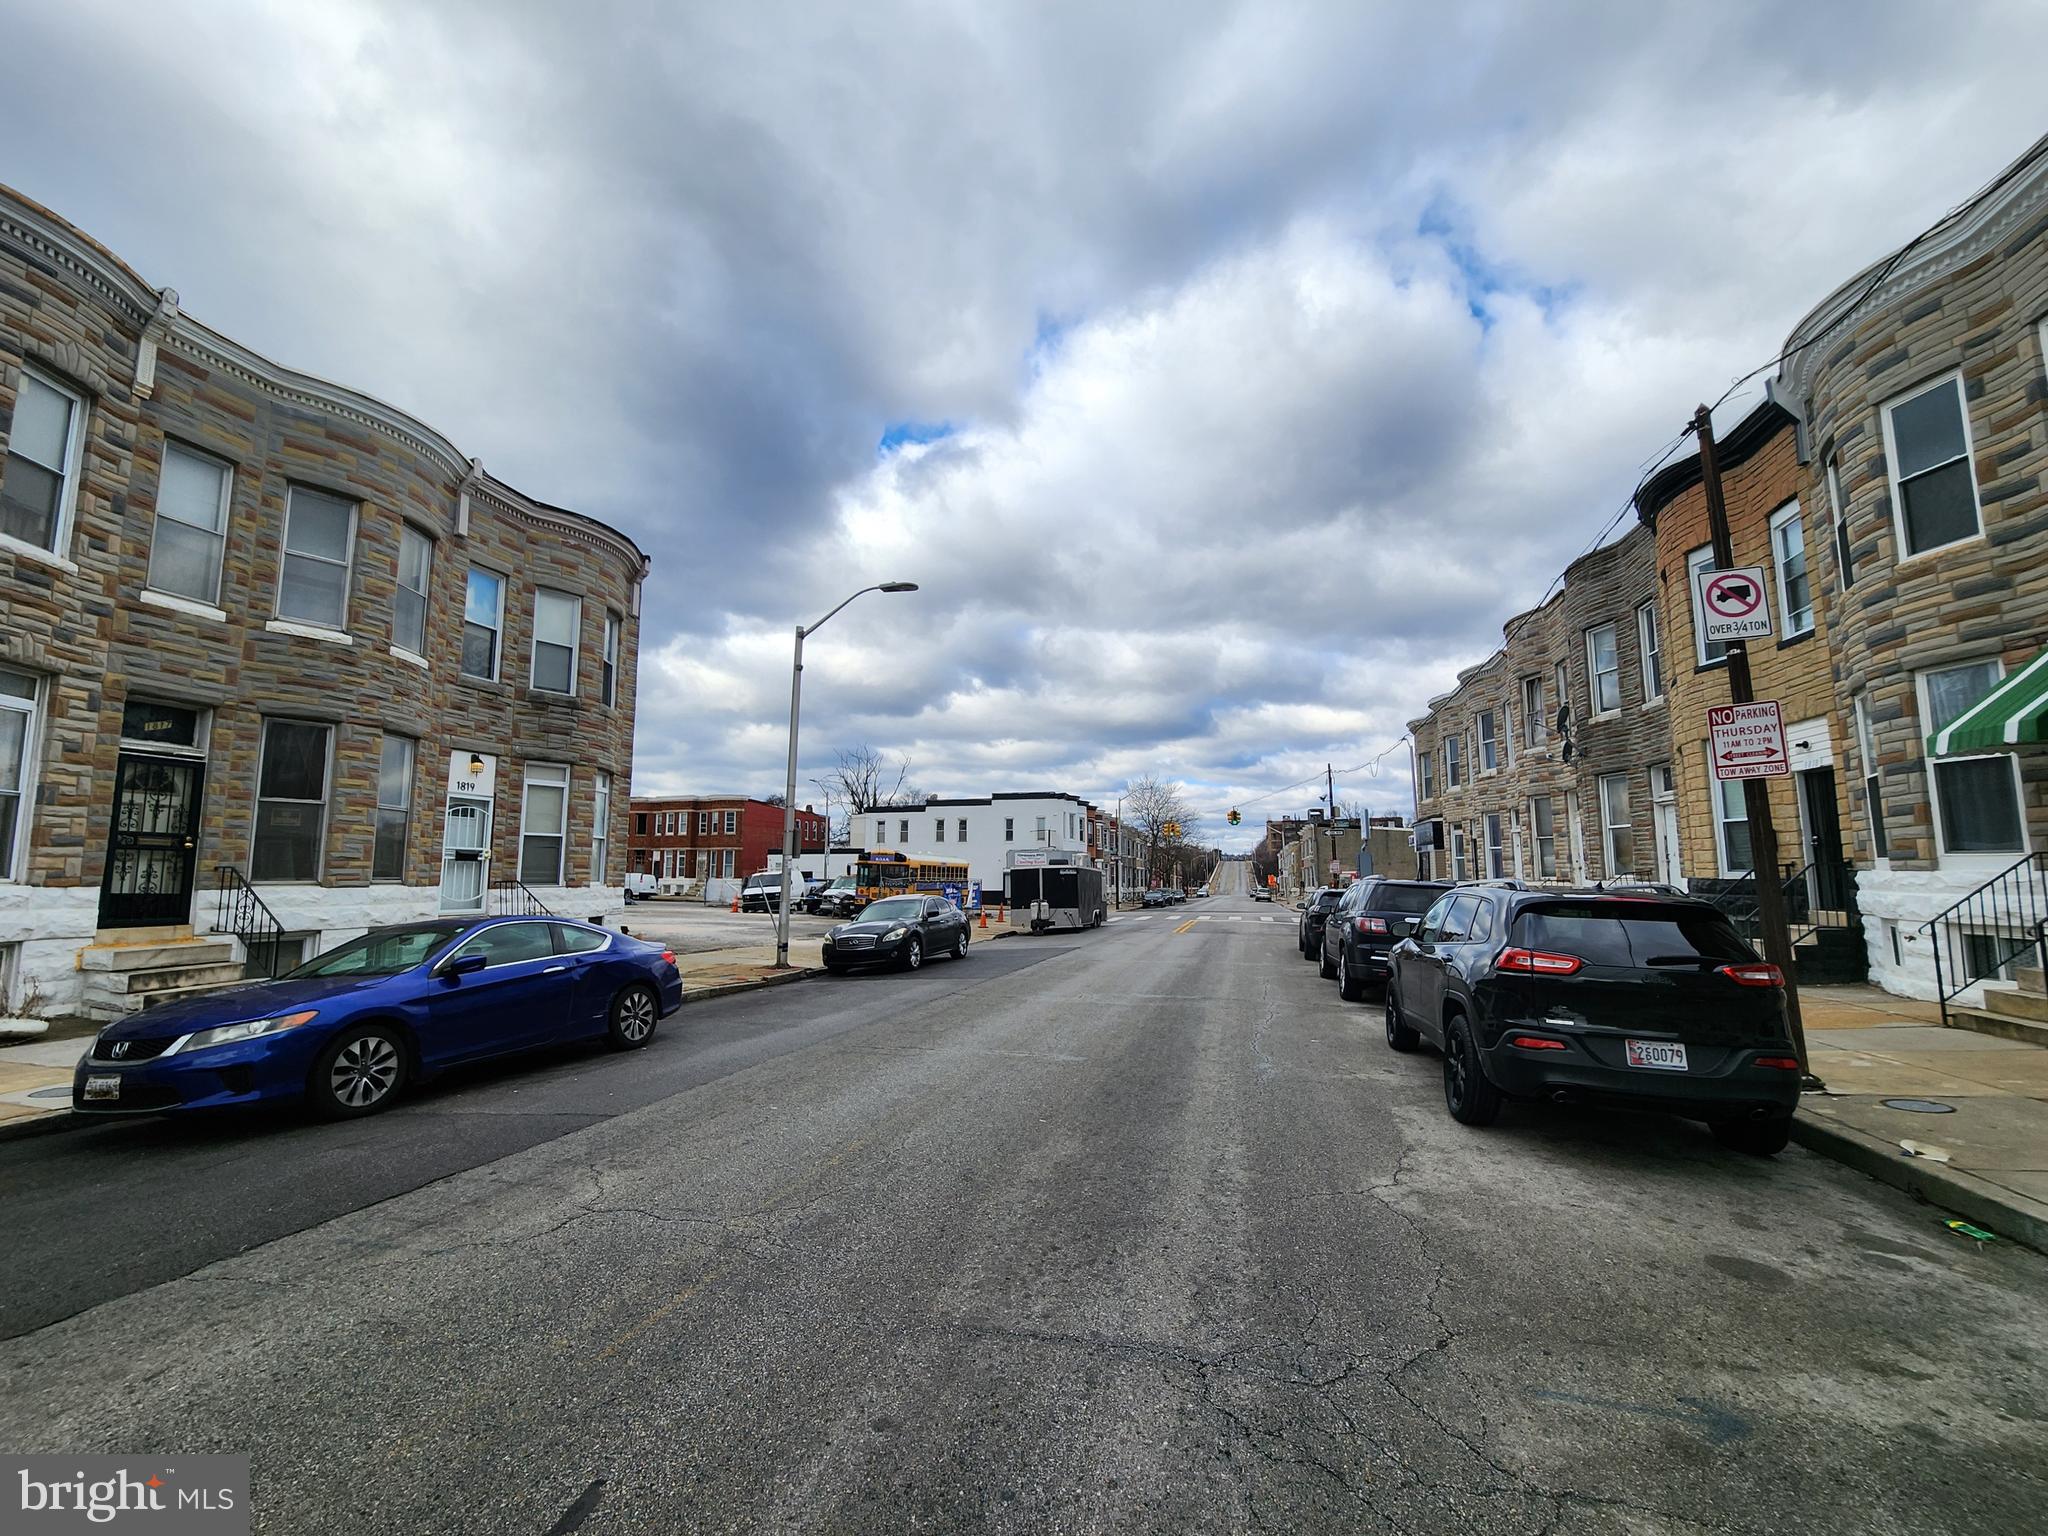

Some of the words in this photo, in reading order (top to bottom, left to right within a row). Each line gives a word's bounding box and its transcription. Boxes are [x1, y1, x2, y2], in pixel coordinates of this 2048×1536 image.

[1710, 624, 1732, 634] OVER
[1732, 620, 1748, 634] 3/4
[1748, 620, 1768, 631] TON
[1711, 710, 1733, 725] NO
[1735, 706, 1775, 720] PARKING
[1714, 723, 1778, 738] THURSDAY
[1720, 768, 1736, 776] TOW
[1739, 766, 1761, 775] AWAY
[1764, 764, 1785, 773] ZONE
[457, 781, 475, 791] 1819
